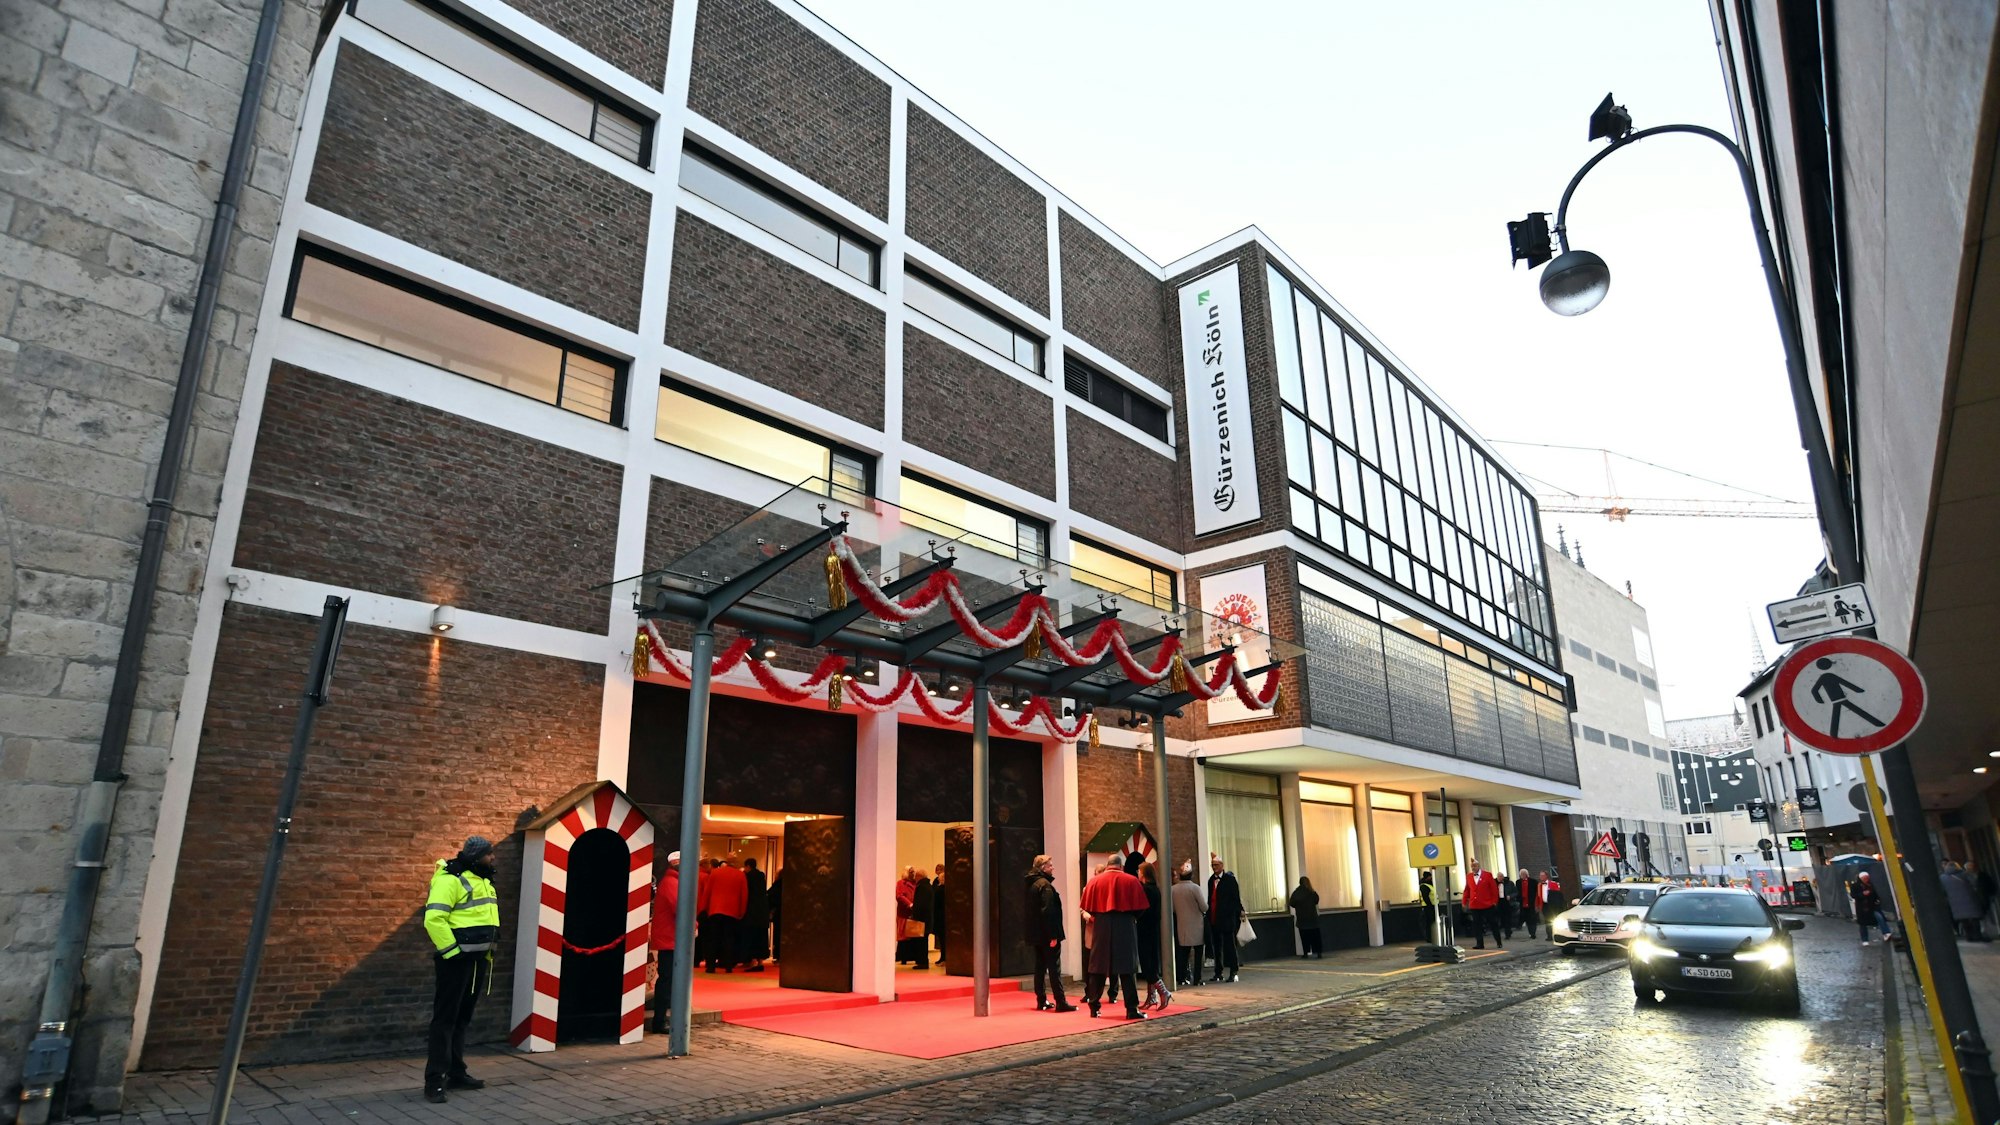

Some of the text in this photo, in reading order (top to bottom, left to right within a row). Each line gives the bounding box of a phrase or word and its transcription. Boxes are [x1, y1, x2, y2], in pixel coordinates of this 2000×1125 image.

[1203, 304, 1236, 512] Gürzenich Köln
[1687, 967, 1692, 975] K
